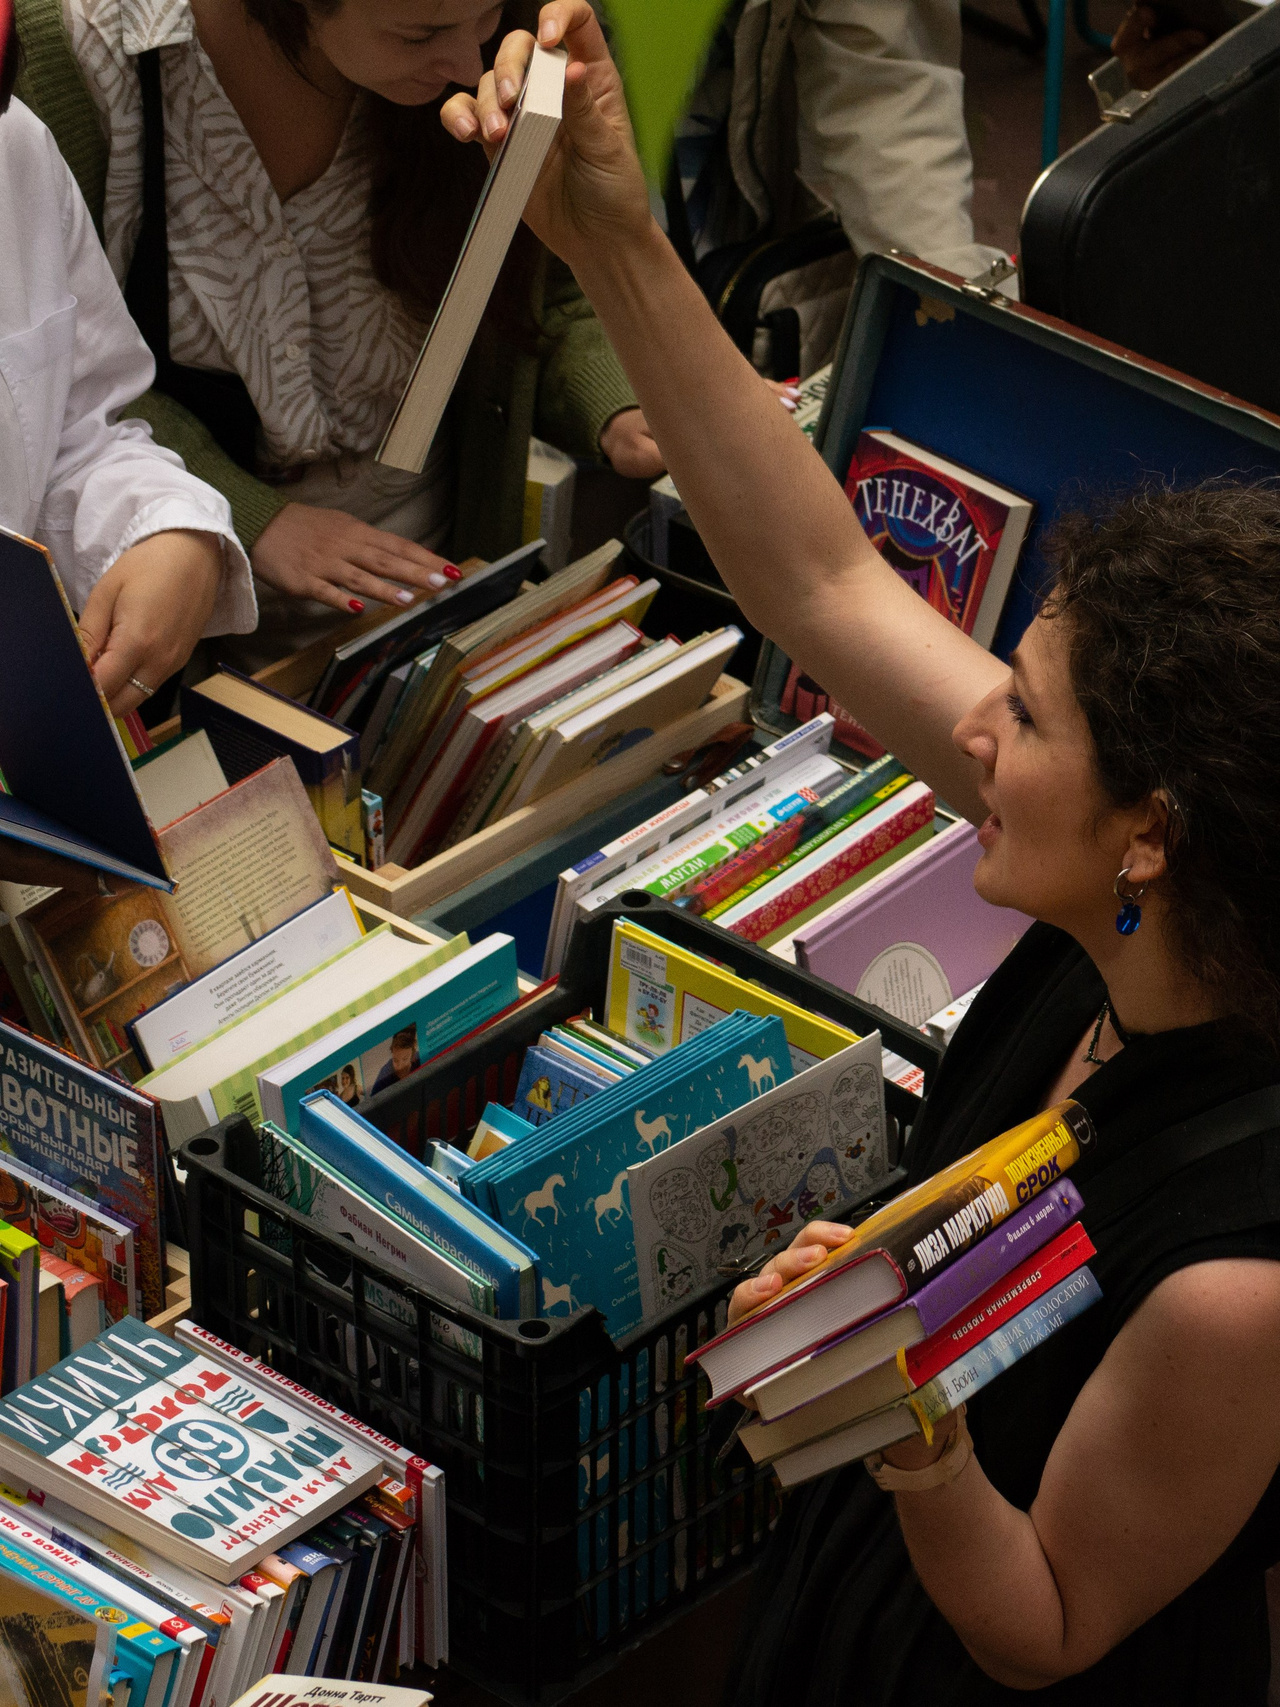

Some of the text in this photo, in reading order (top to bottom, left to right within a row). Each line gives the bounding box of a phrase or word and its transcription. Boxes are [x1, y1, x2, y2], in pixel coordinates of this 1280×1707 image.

[857, 478, 989, 566] ТЕНЕХВАТ
[659, 854, 707, 889] МАУГЛИ
[0, 1073, 145, 1184] ВОТНЫЕ,
[0, 1110, 110, 1176] ОРЫЕ ВЫГЛЯДЯТ
[12, 1130, 101, 1186] ПРИШЕЛЬЦЫ
[1004, 1121, 1071, 1185] ПОЖИЗНЕННЫЙ
[1014, 1154, 1061, 1204] СРОК
[340, 1205, 407, 1262] Фабиан Негрин
[385, 1192, 500, 1292] Самые красивые
[912, 1181, 1012, 1272] ЛИЗА МАРКЛУНД
[1006, 1220, 1030, 1244] Фиалки
[1034, 1202, 1055, 1224] марте
[950, 1270, 1043, 1342] СОВРЕМЕННАЯ ЛЮБОВЬ
[978, 1323, 1025, 1366] МАЛЬЧИК
[1024, 1317, 1034, 1330] В
[1032, 1272, 1090, 1323] ПОЛОСАТОЙ
[1019, 1311, 1064, 1353] ПИЖАМЕ
[0, 1333, 182, 1444] ЧАЙКИ
[254, 1361, 337, 1414] ПОТЕРЯННОМ
[339, 1412, 402, 1452] ВРЕМЕНИ
[66, 1365, 231, 1480] ТОЛСТОЙ
[156, 1415, 242, 1486] 69
[122, 1470, 179, 1510] ДЛЯ
[175, 1424, 343, 1536] ПРАВИЛО
[303, 1454, 353, 1496] ДАРЬЯ
[219, 1492, 303, 1550] ВАРДЕНБУРГ
[32, 1537, 80, 1567] ВОЙНЕ
[104, 1548, 152, 1580] КАШТАНКА
[72, 1592, 99, 1607] ДУ
[304, 1686, 347, 1698] Донна
[348, 1690, 386, 1703] Тартт
